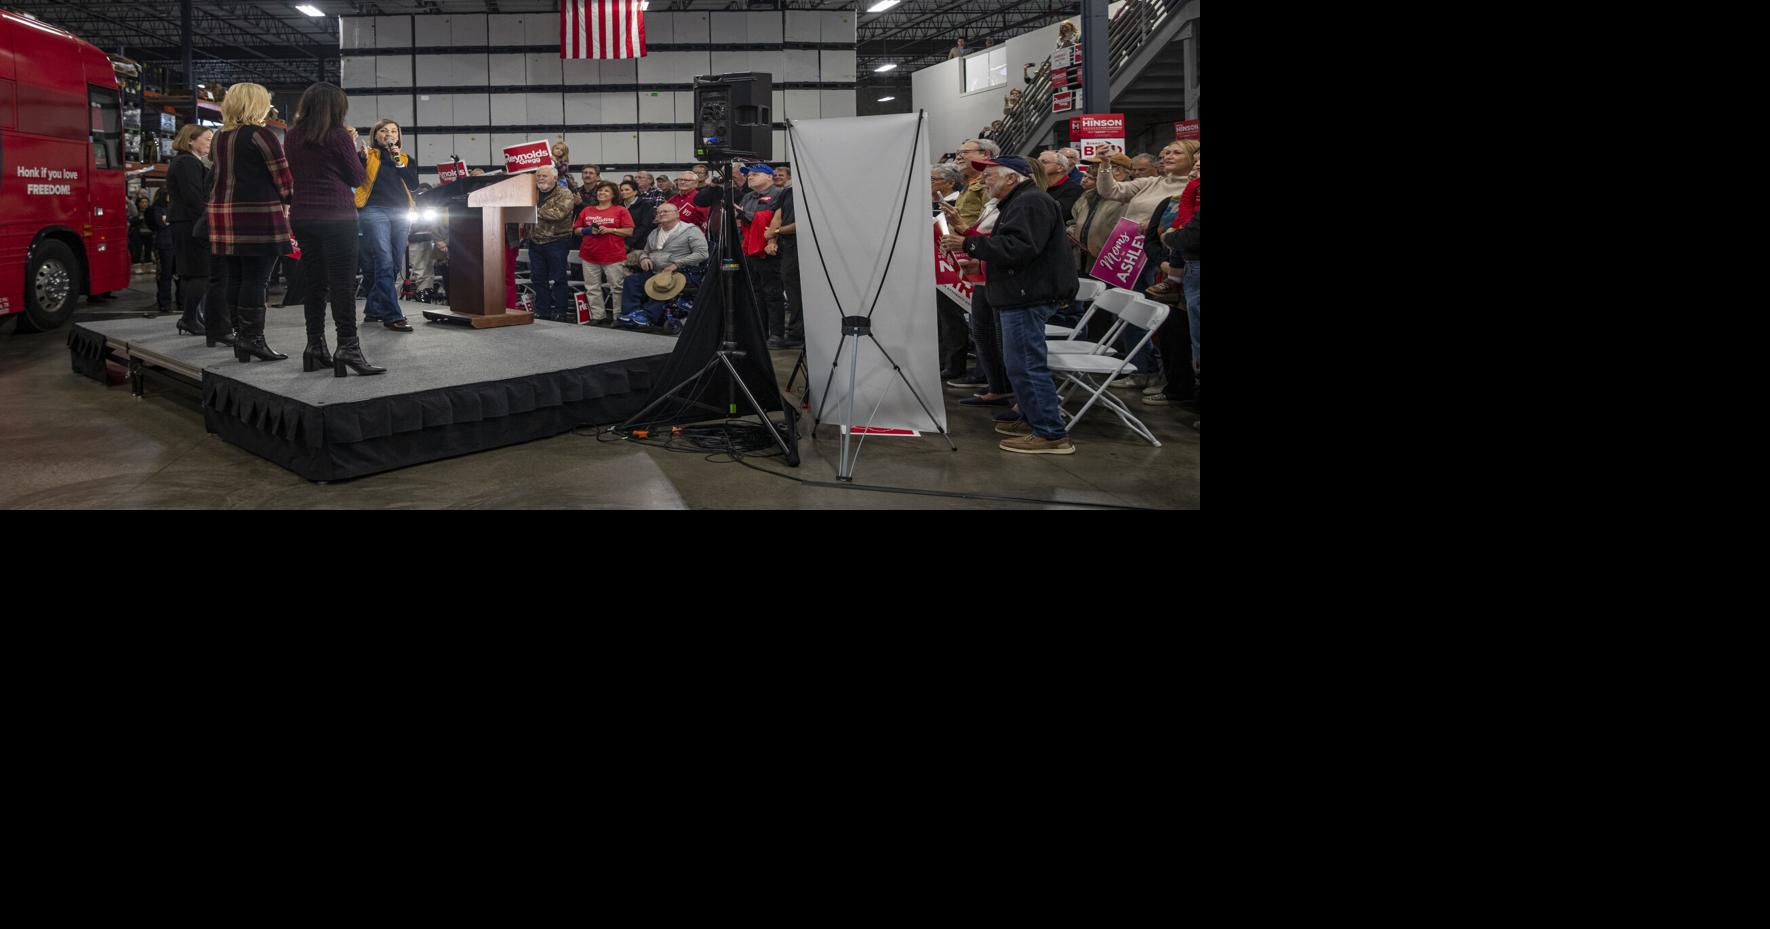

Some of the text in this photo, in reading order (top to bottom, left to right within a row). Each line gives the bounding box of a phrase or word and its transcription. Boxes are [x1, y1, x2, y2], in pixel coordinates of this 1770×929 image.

[1082, 119, 1123, 127] HINSON
[504, 149, 549, 164] Reynolds
[17, 166, 78, 181] Honk if you love
[27, 183, 71, 195] FREEDOM!
[1099, 232, 1130, 271] Moms
